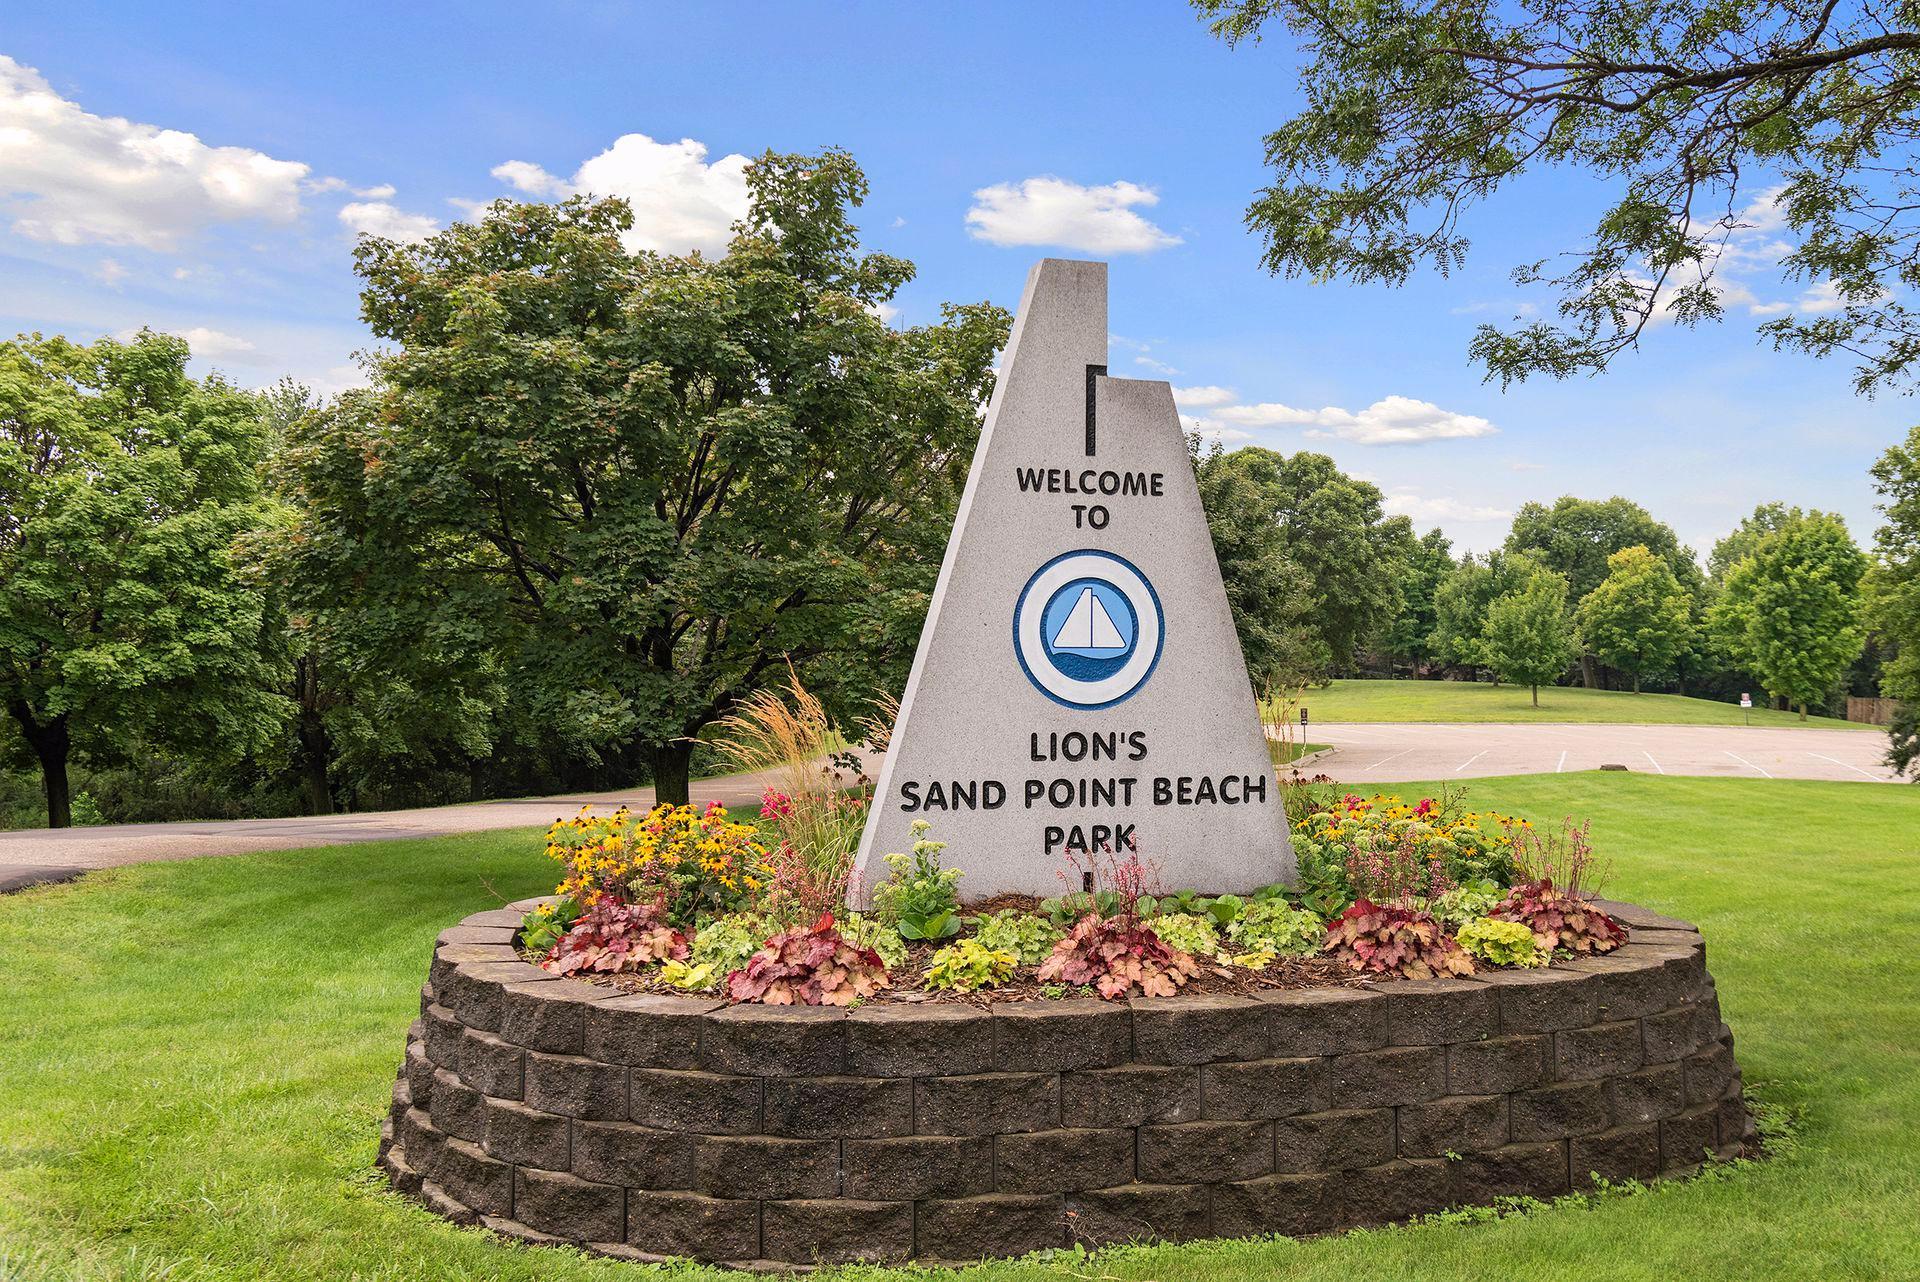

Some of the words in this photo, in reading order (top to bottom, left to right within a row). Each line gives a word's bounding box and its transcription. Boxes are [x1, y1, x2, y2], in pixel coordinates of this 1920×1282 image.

[1016, 467, 1164, 497] WELCOME
[1070, 504, 1111, 530] TO
[1029, 730, 1149, 763] LION'S
[899, 779, 1007, 813] SAND
[1023, 776, 1139, 810] POINT
[1152, 773, 1268, 806] BEACH
[1043, 822, 1138, 856] PARK
